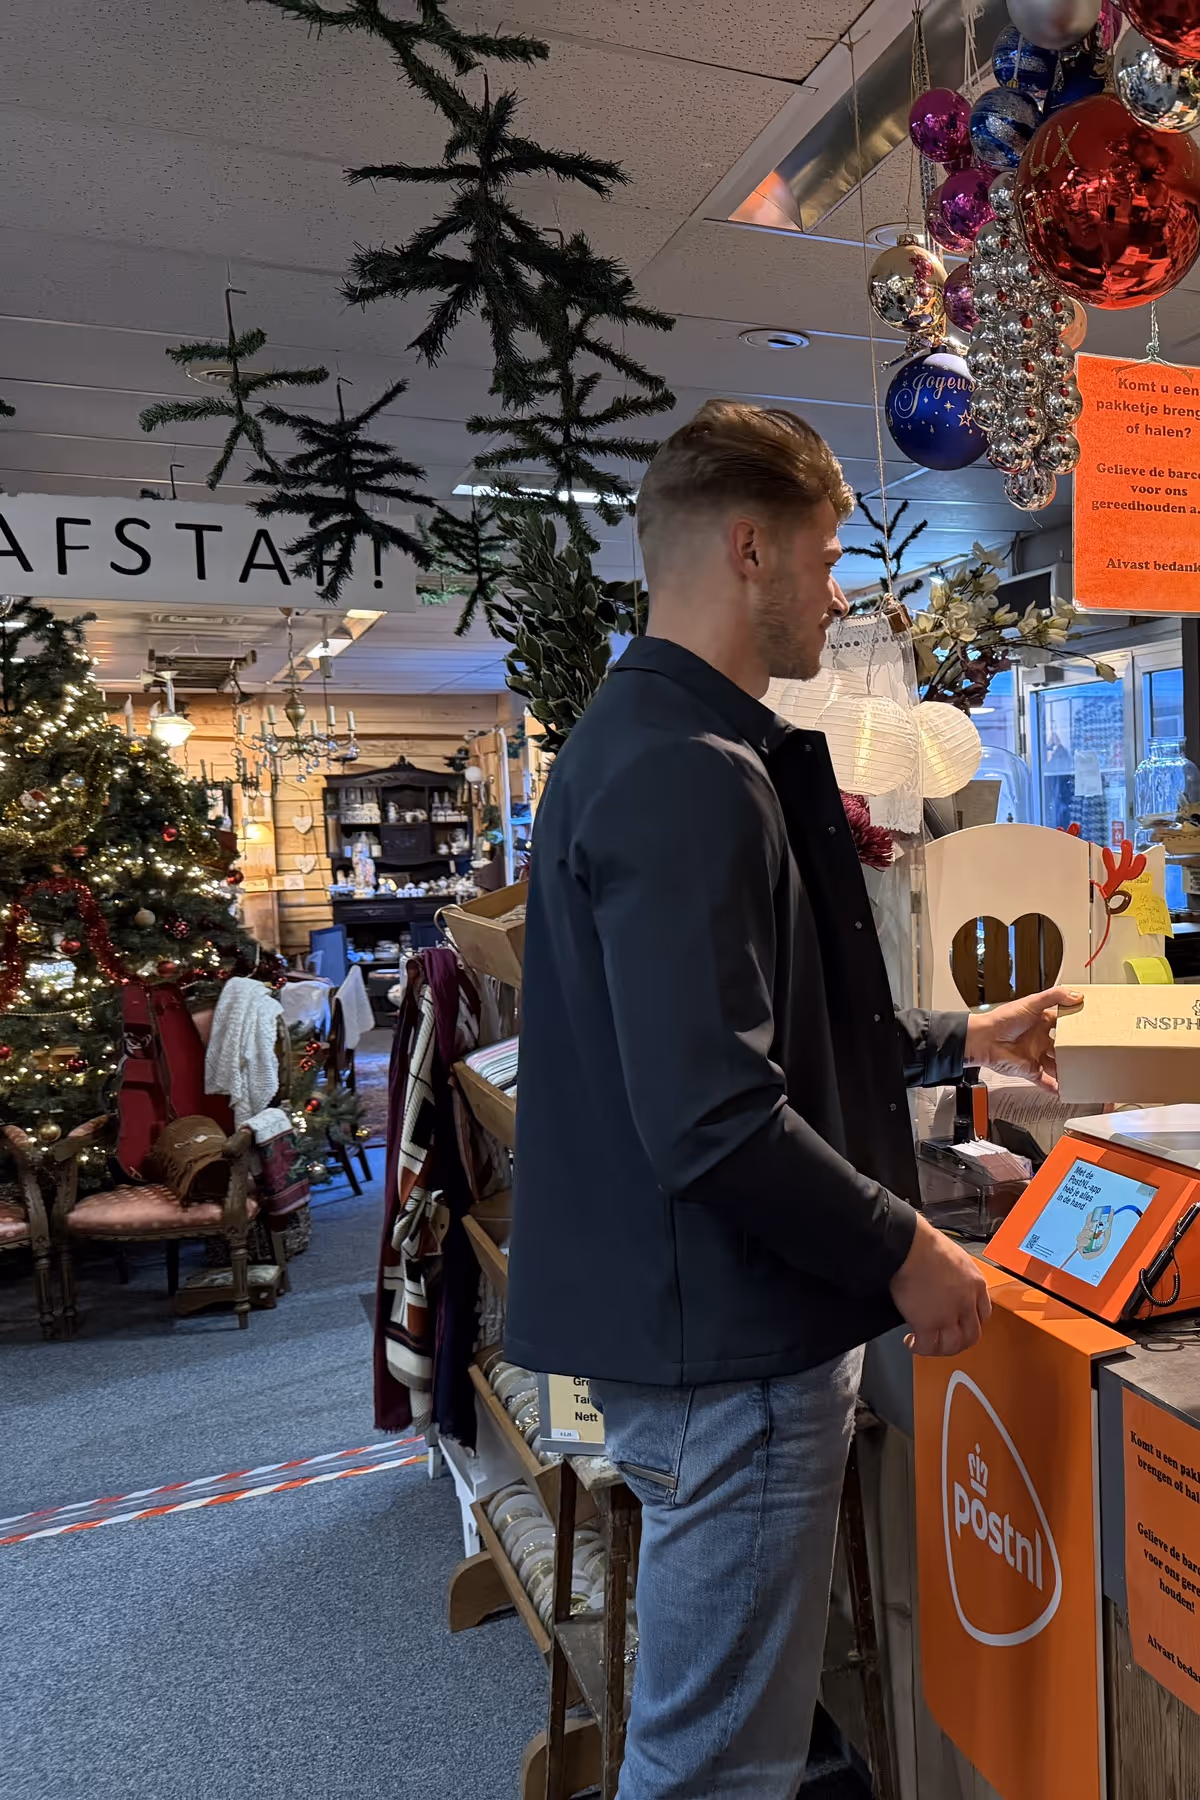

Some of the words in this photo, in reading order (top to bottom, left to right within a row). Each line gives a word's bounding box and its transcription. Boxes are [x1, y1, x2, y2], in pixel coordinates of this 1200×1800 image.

[1118, 377, 1156, 393] Komt
[1161, 385, 1169, 394] u
[1174, 386, 1199, 396] een
[1096, 400, 1158, 416] pakketje
[1126, 423, 1140, 434] of
[1145, 424, 1192, 438] halen?
[1096, 463, 1146, 476] Gelieve
[1149, 467, 1165, 478] de
[1130, 484, 1161, 495] voor
[1165, 487, 1188, 497] ons
[1091, 500, 1187, 514] gereedhouden
[1106, 558, 1150, 570] Alvast
[1074, 1166, 1086, 1177] Met
[1085, 1170, 1094, 1180] de
[1062, 1183, 1074, 1195] heb
[1071, 1187, 1080, 1197] je
[1079, 1191, 1094, 1203] alles
[1068, 1174, 1102, 1195] PostNL-app
[1056, 1192, 1064, 1202] in
[1062, 1195, 1071, 1205] de
[1070, 1197, 1087, 1211] hand
[1130, 1430, 1155, 1455] Komt
[1155, 1448, 1162, 1459] u
[1163, 1453, 1179, 1471] een
[1137, 1454, 1173, 1487] brengen
[1174, 1481, 1184, 1494] of
[954, 1481, 1042, 1592] postnl
[1137, 1522, 1169, 1553] Gelieve
[1169, 1545, 1181, 1562] de
[1143, 1548, 1163, 1570] voor
[1165, 1564, 1180, 1583] ons
[1159, 1577, 1195, 1615] houden!
[1147, 1633, 1176, 1665] Alvast
